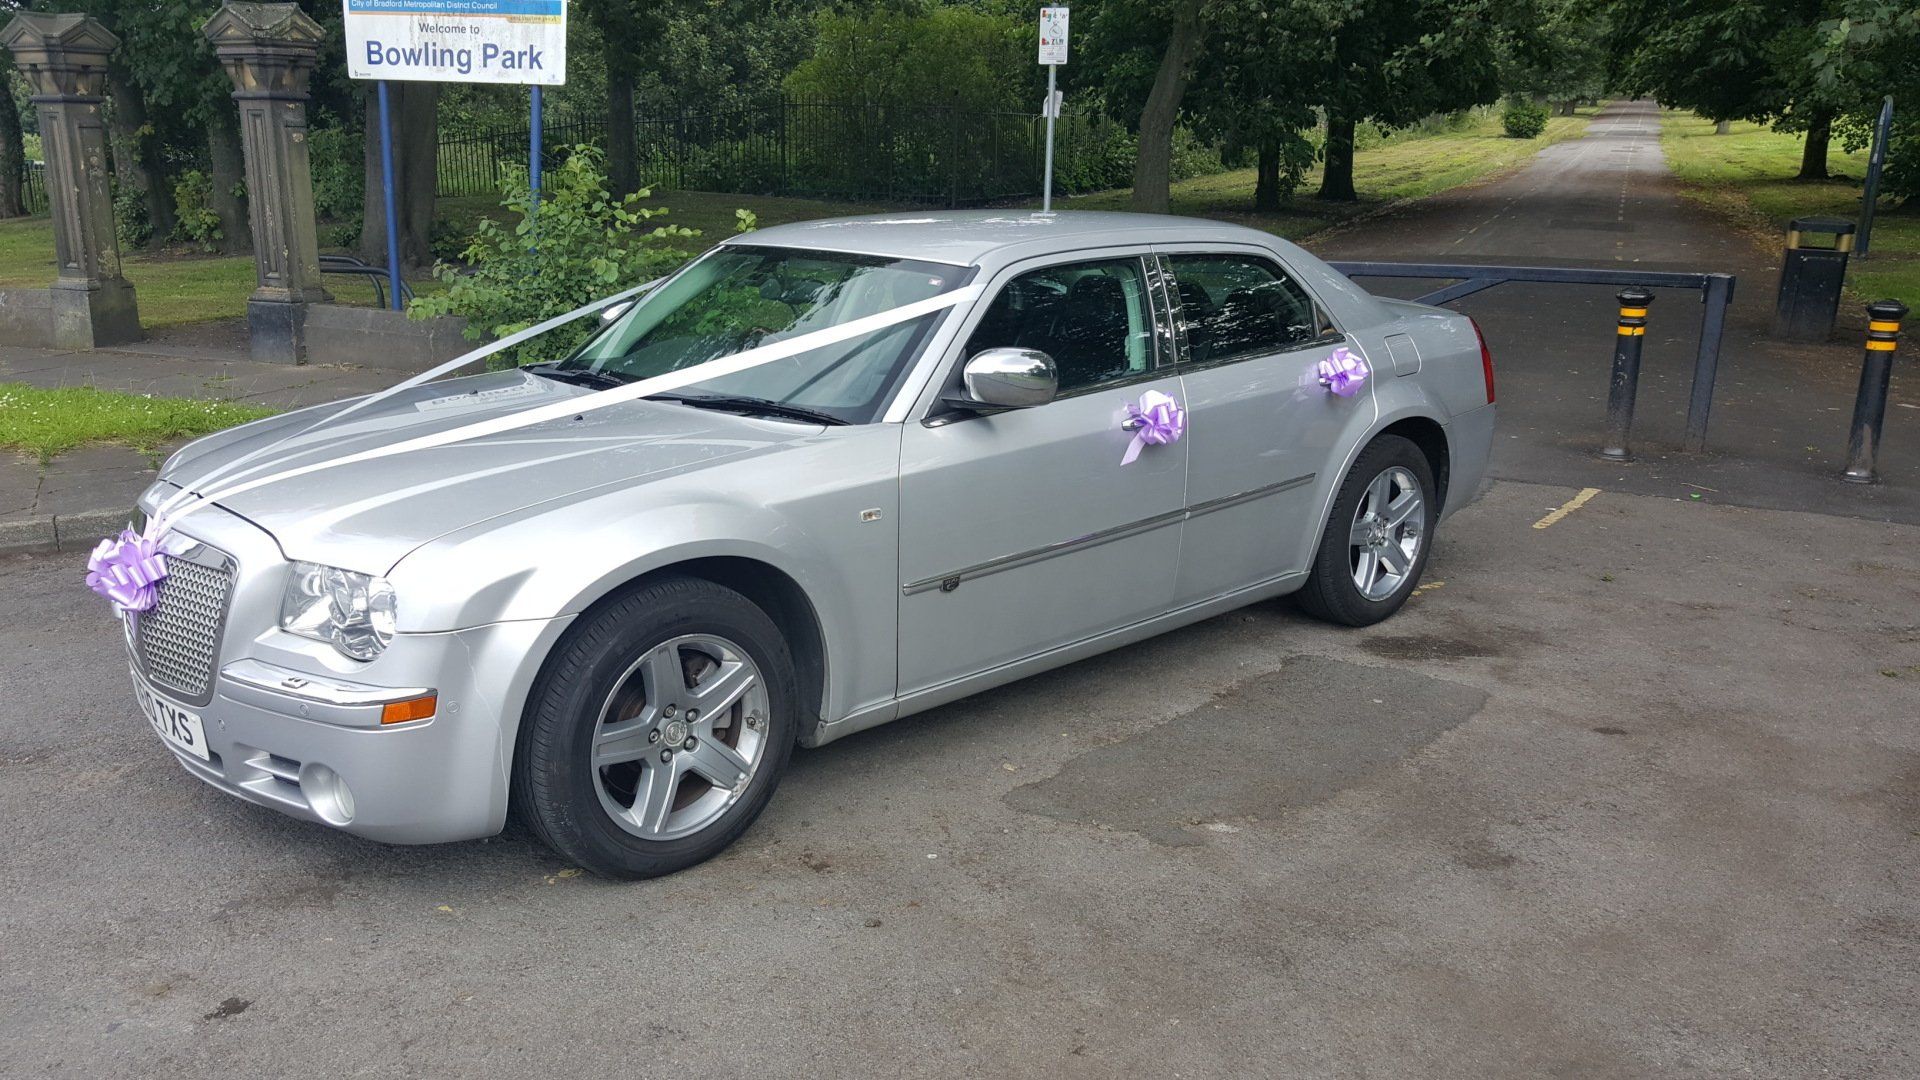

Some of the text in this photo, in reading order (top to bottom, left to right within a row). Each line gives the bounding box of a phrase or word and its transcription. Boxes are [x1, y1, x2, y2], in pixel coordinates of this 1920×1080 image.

[351, 0, 364, 8] City
[374, 0, 402, 8] Bradford
[404, 1, 445, 9] Metropolitan
[447, 1, 470, 9] District
[418, 22, 480, 34] Welcome to
[366, 40, 543, 74] Bowling Park
